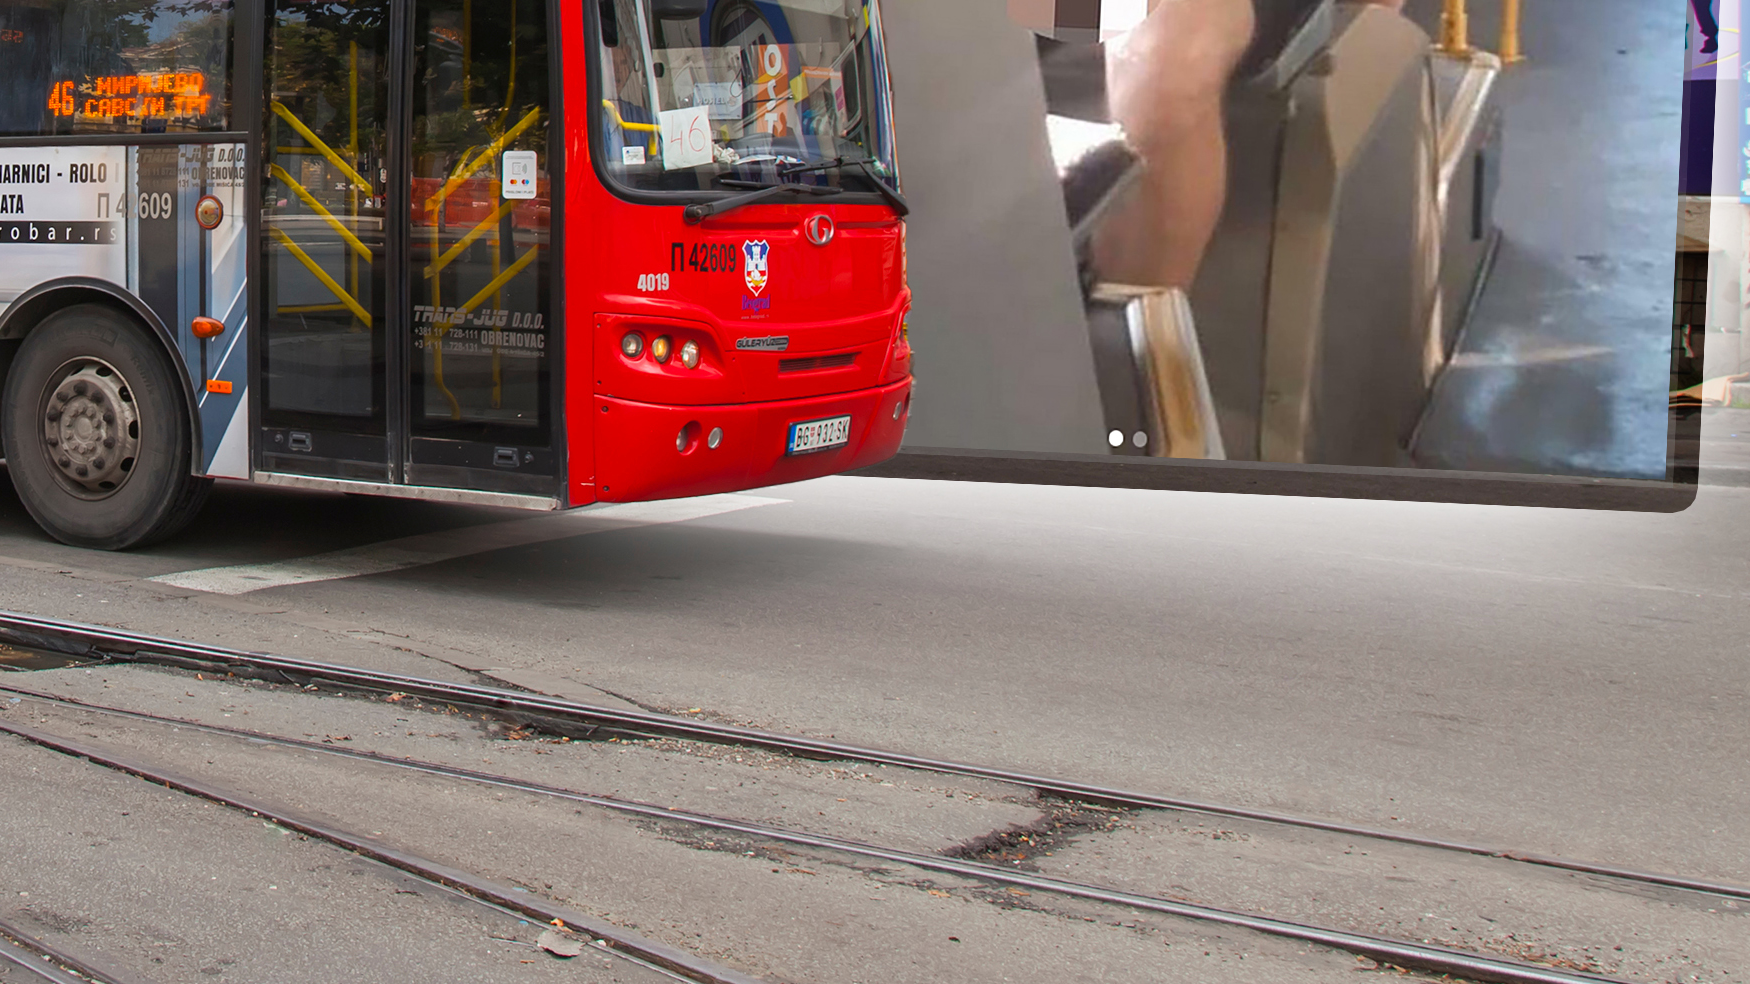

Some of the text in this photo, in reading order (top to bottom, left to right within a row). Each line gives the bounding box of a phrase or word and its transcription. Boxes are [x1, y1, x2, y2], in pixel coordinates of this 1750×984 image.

[49, 81, 74, 116] 46
[670, 114, 707, 156] 46
[69, 162, 108, 184] ROLO
[688, 242, 737, 273] 42609
[636, 272, 670, 292] 4019
[511, 311, 545, 329] D.O.O.
[414, 339, 431, 349] +31
[480, 329, 545, 348] OBRENOVAC
